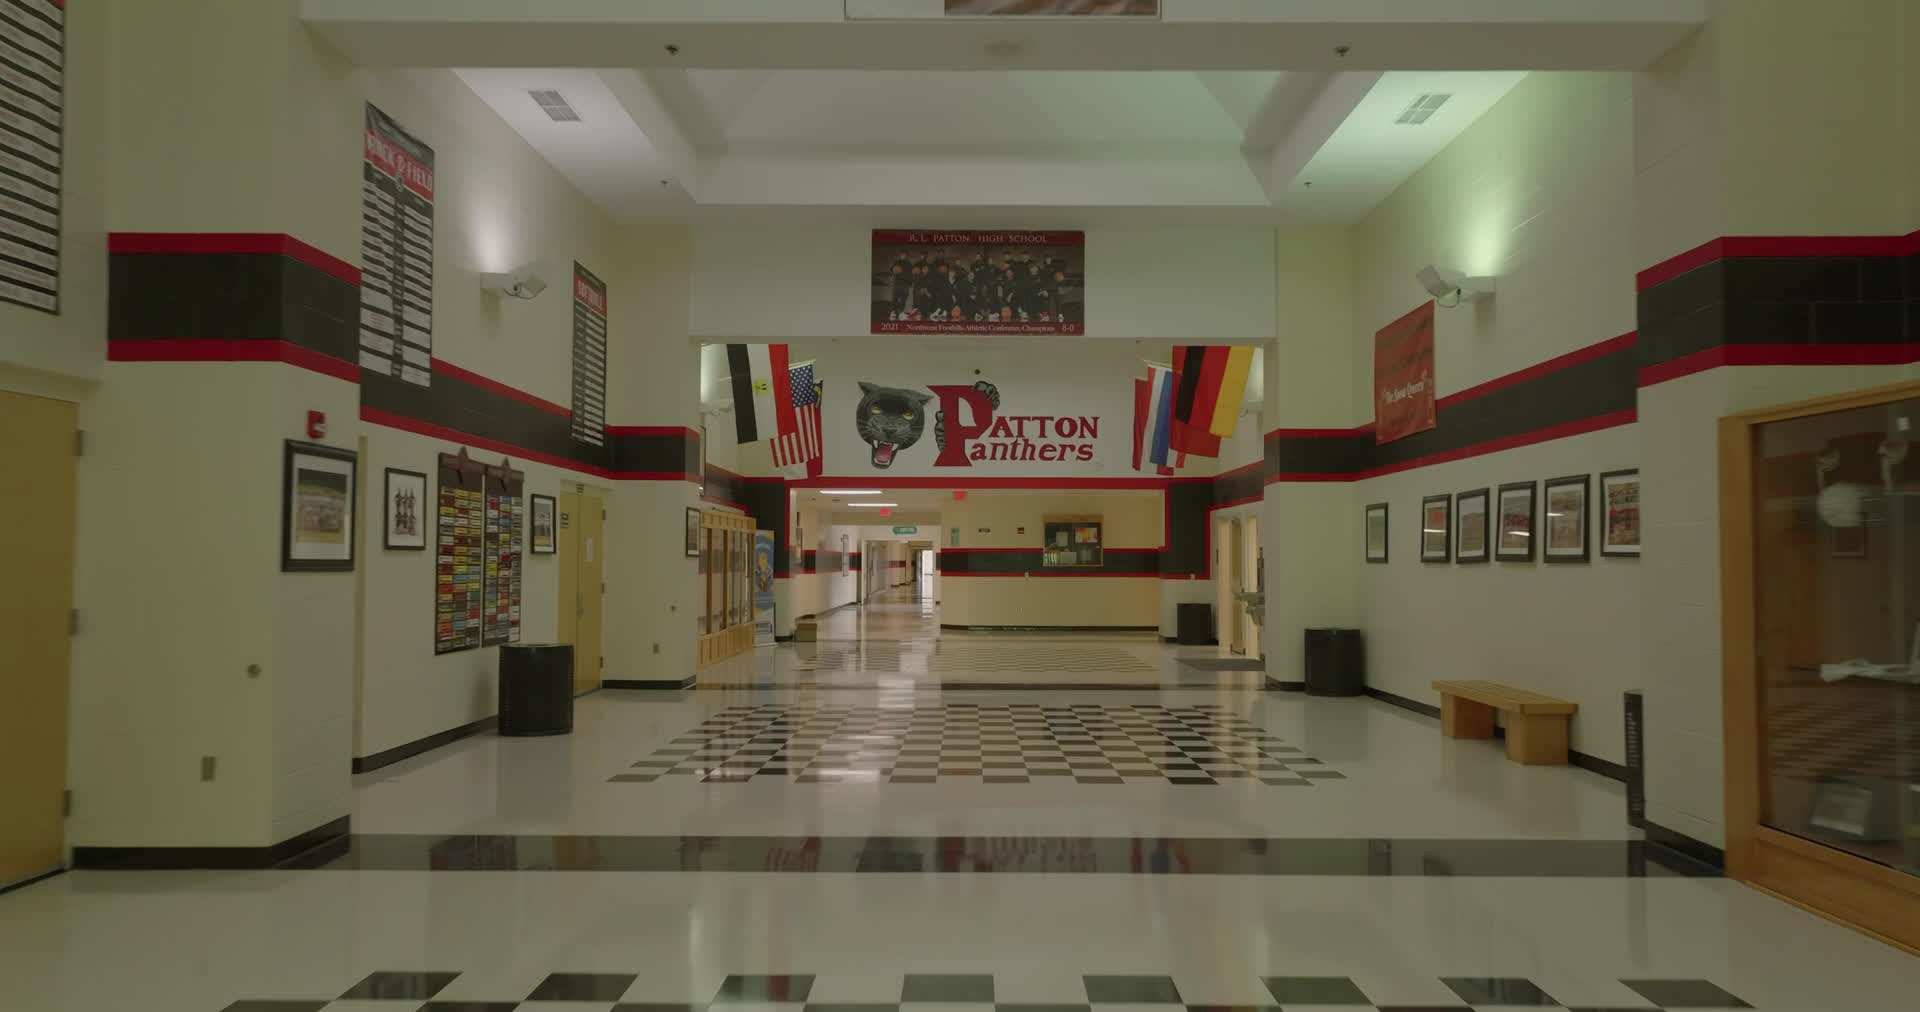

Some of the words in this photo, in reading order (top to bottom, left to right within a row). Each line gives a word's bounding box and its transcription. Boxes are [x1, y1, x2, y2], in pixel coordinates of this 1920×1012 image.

[407, 160, 433, 192] FIELD
[933, 233, 969, 243] PATTON
[978, 233, 1004, 243] HIGH
[1007, 233, 1048, 243] SCHOOL
[881, 322, 898, 331] 2021
